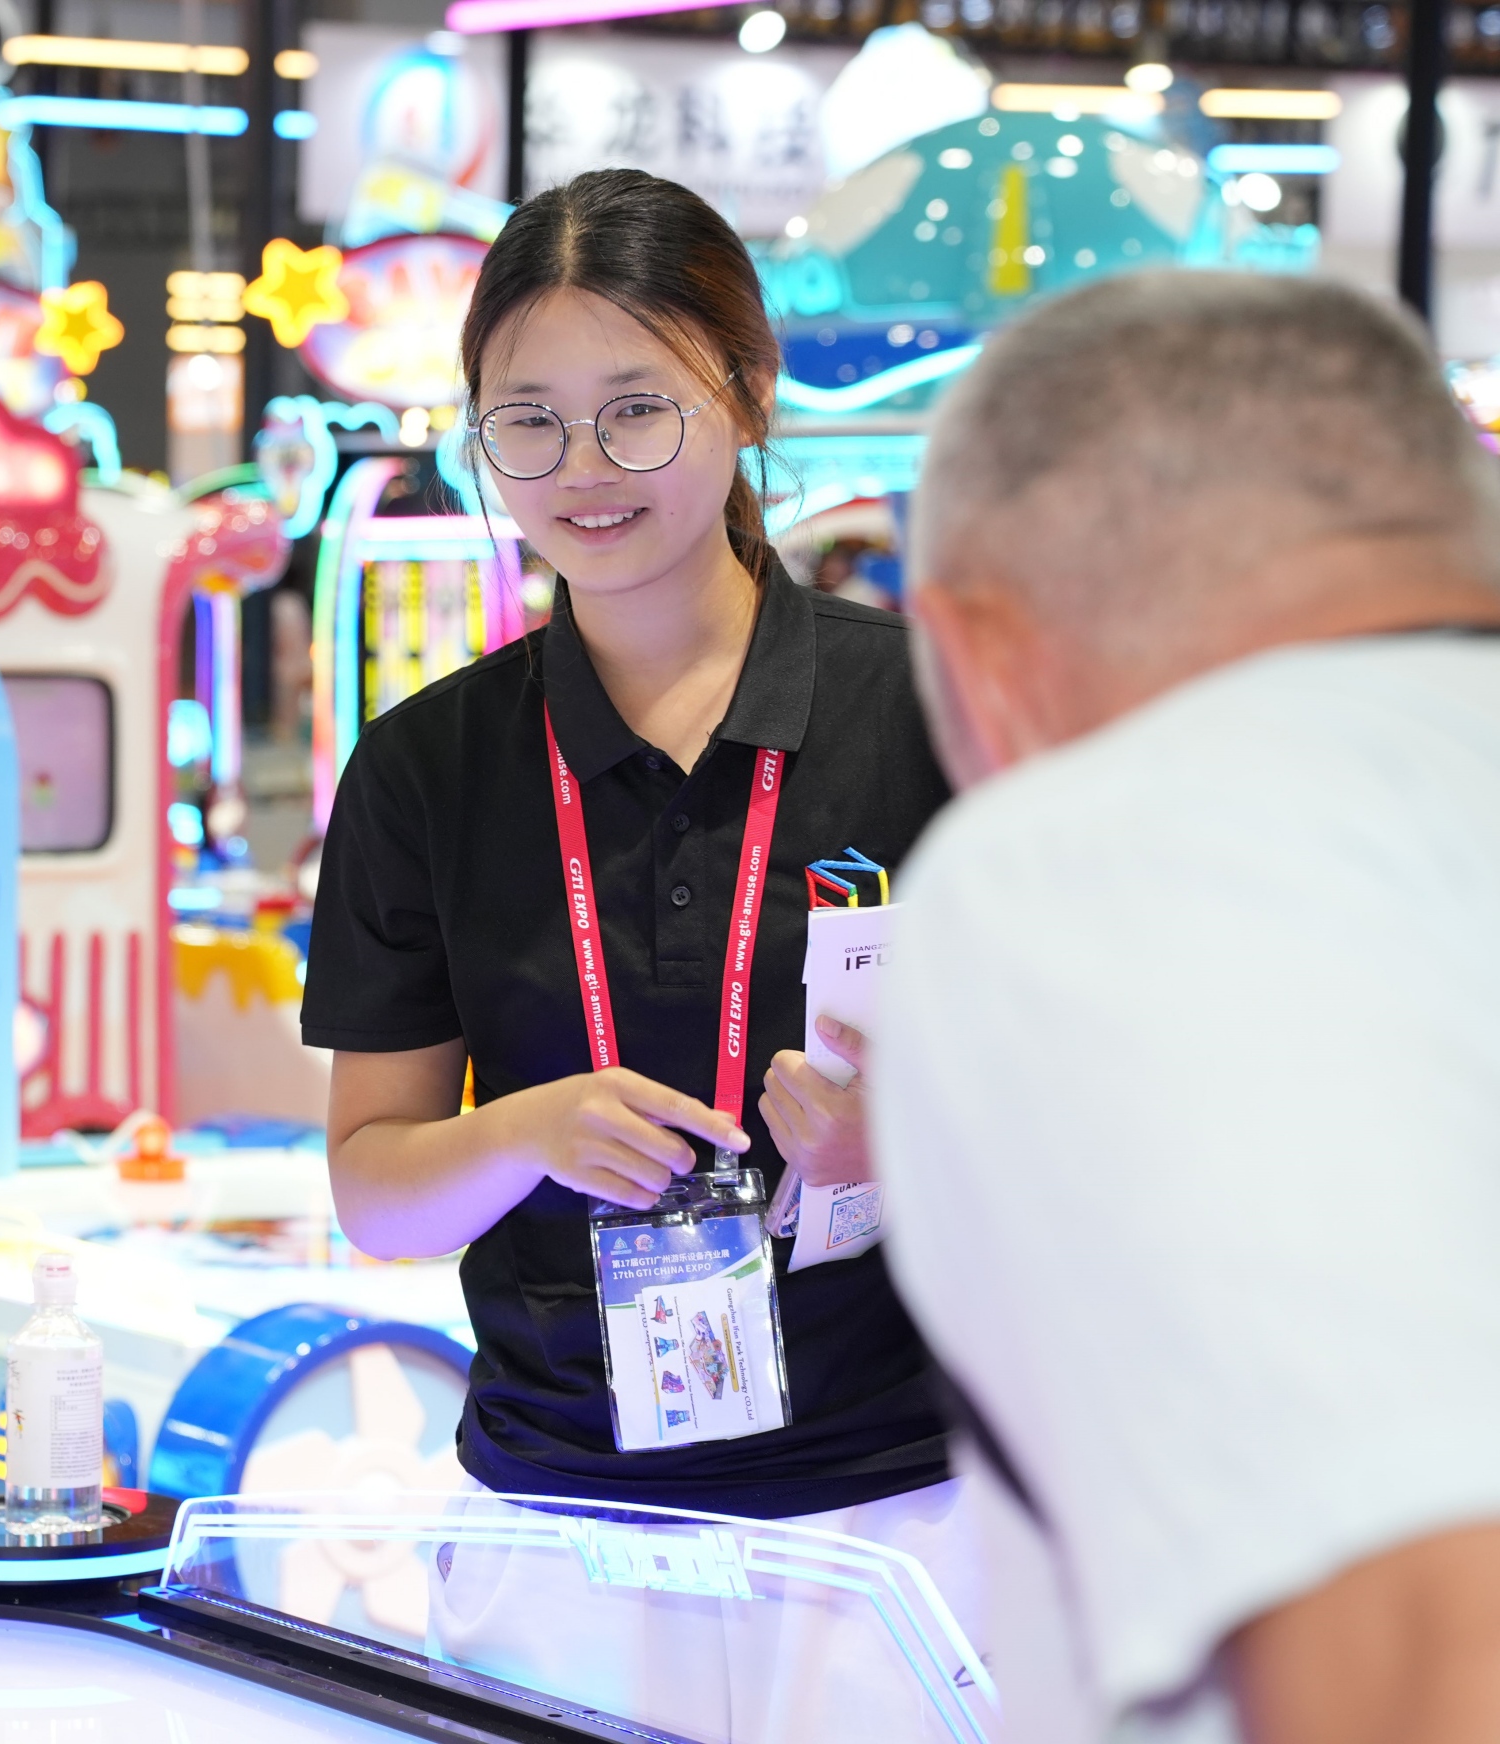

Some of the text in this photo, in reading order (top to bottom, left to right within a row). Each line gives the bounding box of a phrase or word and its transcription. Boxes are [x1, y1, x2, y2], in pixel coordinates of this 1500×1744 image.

[762, 756, 777, 792] GTI
[569, 857, 610, 1067] GTI EXPO www.gti-amuse.com
[727, 845, 762, 1059] GTI EXPO www.gti-amuse.com
[844, 942, 891, 954] GUANGZH
[832, 1182, 863, 1196] GUAN
[613, 1262, 712, 1280] 17th GTI CHINA EXPO
[726, 1287, 737, 1324] Guangzhou
[735, 1341, 744, 1356] Park
[738, 1357, 749, 1394] Technology
